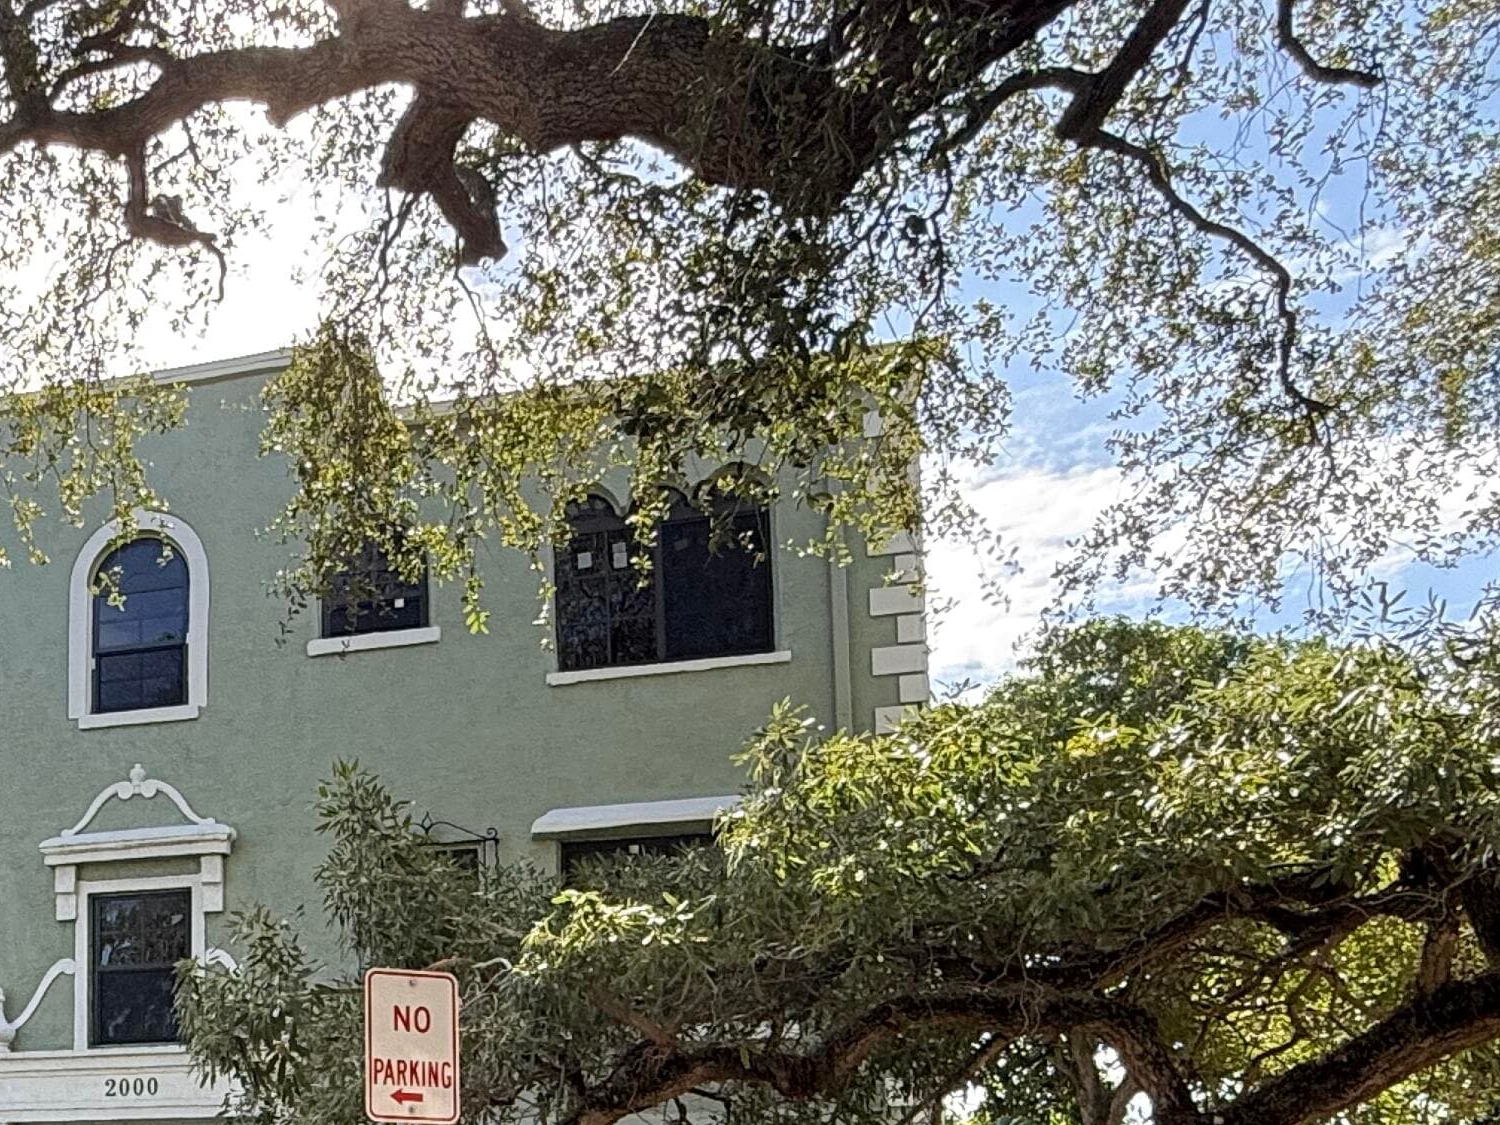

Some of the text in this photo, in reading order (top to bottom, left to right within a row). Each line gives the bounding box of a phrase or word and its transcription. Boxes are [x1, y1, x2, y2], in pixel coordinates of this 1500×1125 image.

[394, 1004, 431, 1033] NO
[105, 1076, 159, 1097] 2000
[373, 1058, 452, 1089] PARKING
